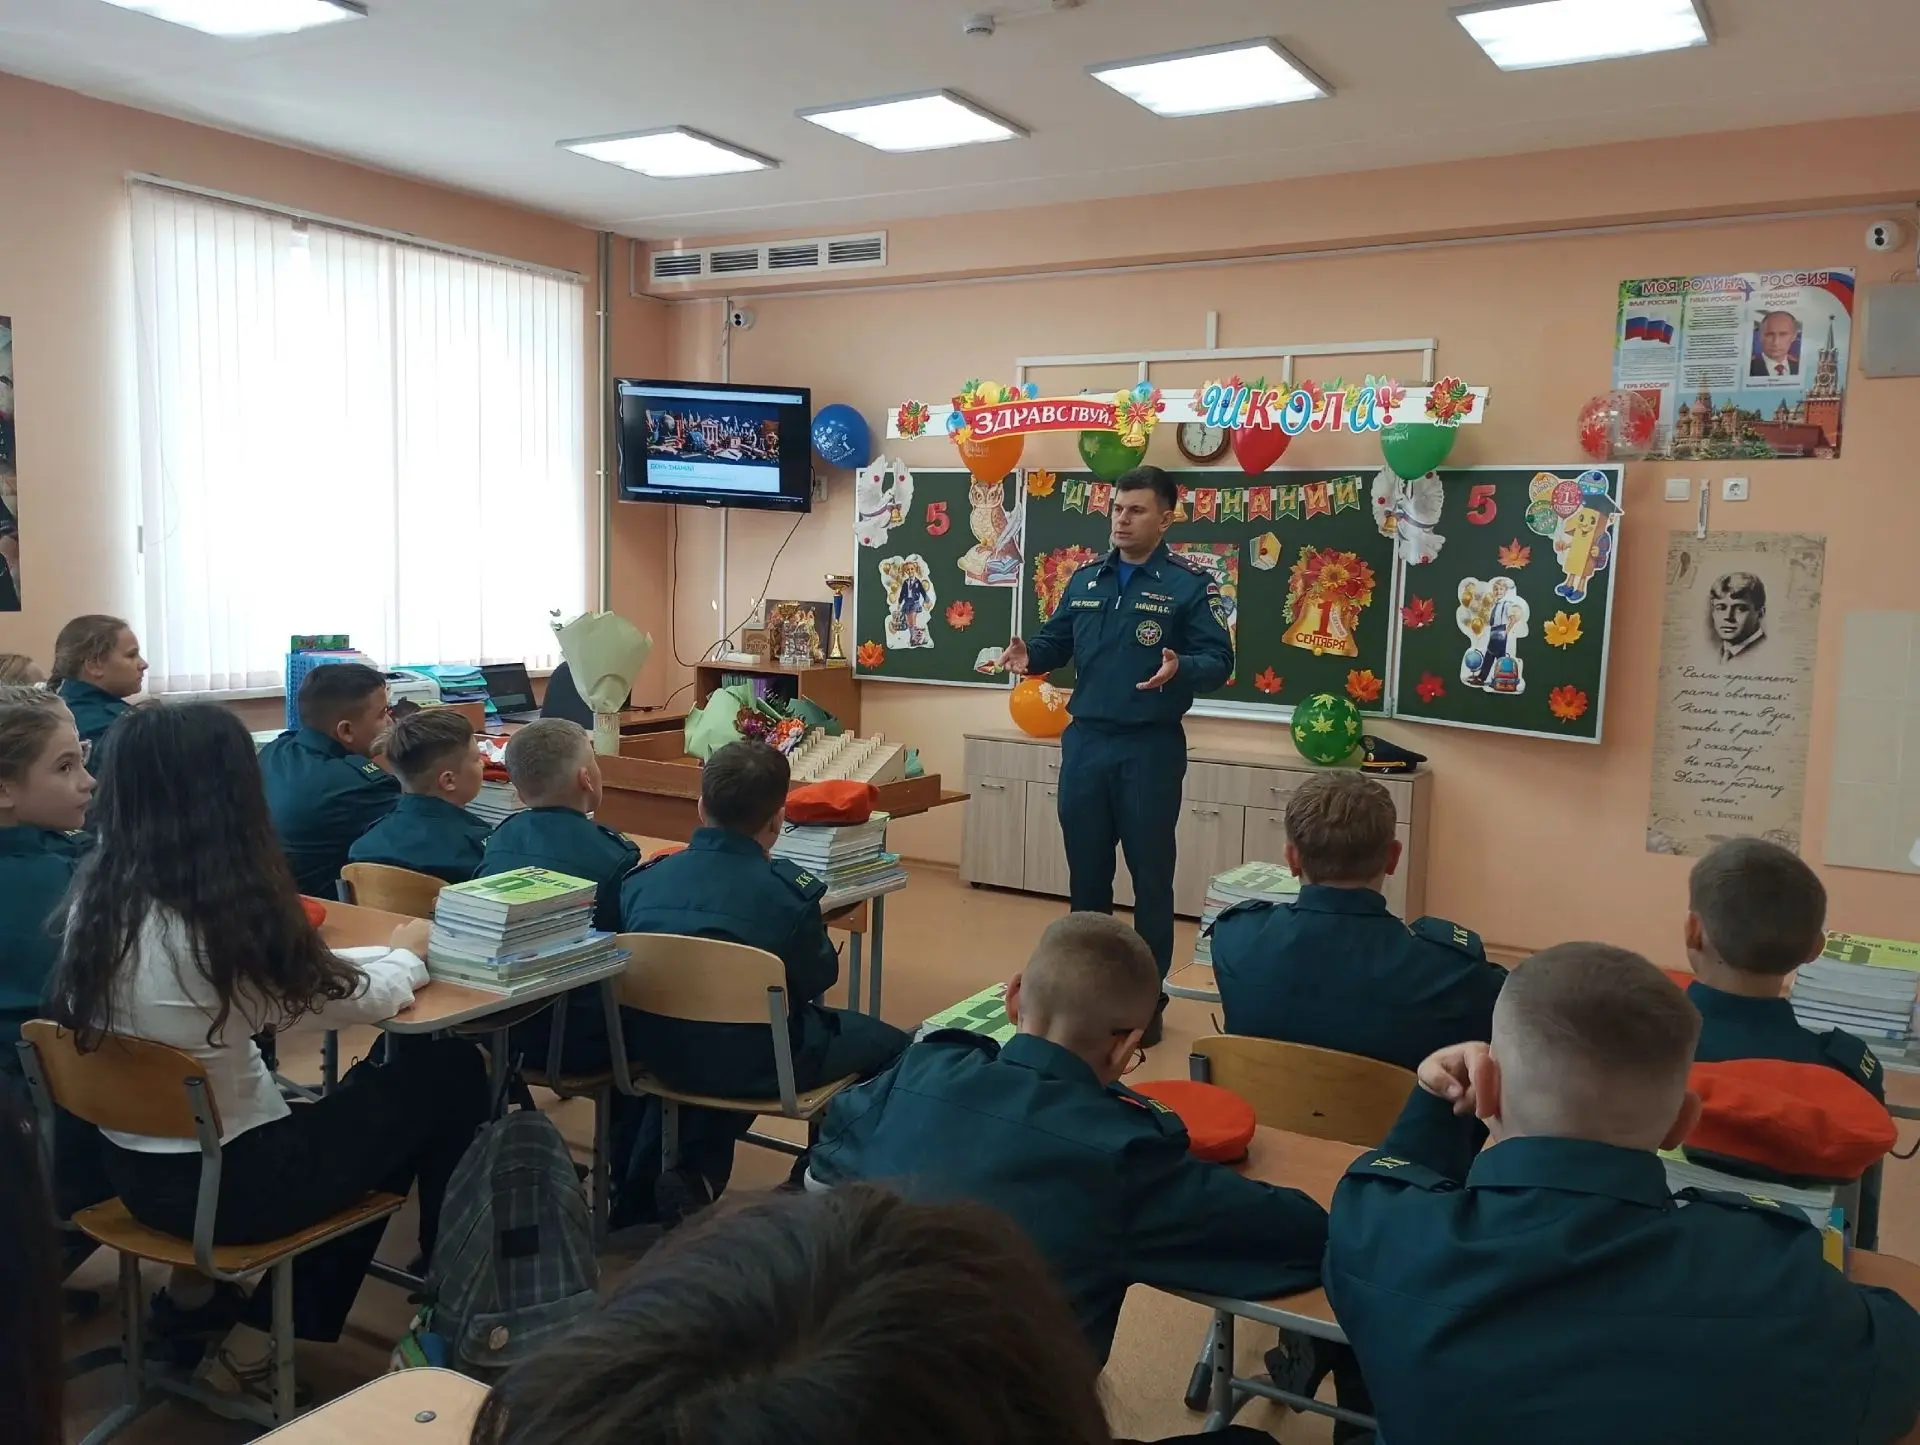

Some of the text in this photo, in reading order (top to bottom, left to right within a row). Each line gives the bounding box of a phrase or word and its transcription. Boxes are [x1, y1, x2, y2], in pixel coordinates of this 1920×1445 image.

[1642, 271, 1829, 295] МОЯ РОДИНА РОССИЯ
[974, 406, 1113, 435] ЗДРАВСТВУЙ,
[1202, 384, 1395, 435] ШКОЛА!
[926, 501, 950, 536] 5
[1466, 484, 1497, 525] 5
[1135, 602, 1157, 611] ЗАЙЦЕВ
[1313, 600, 1333, 637] 1
[1296, 632, 1346, 650] СЕНТЯБРЯ
